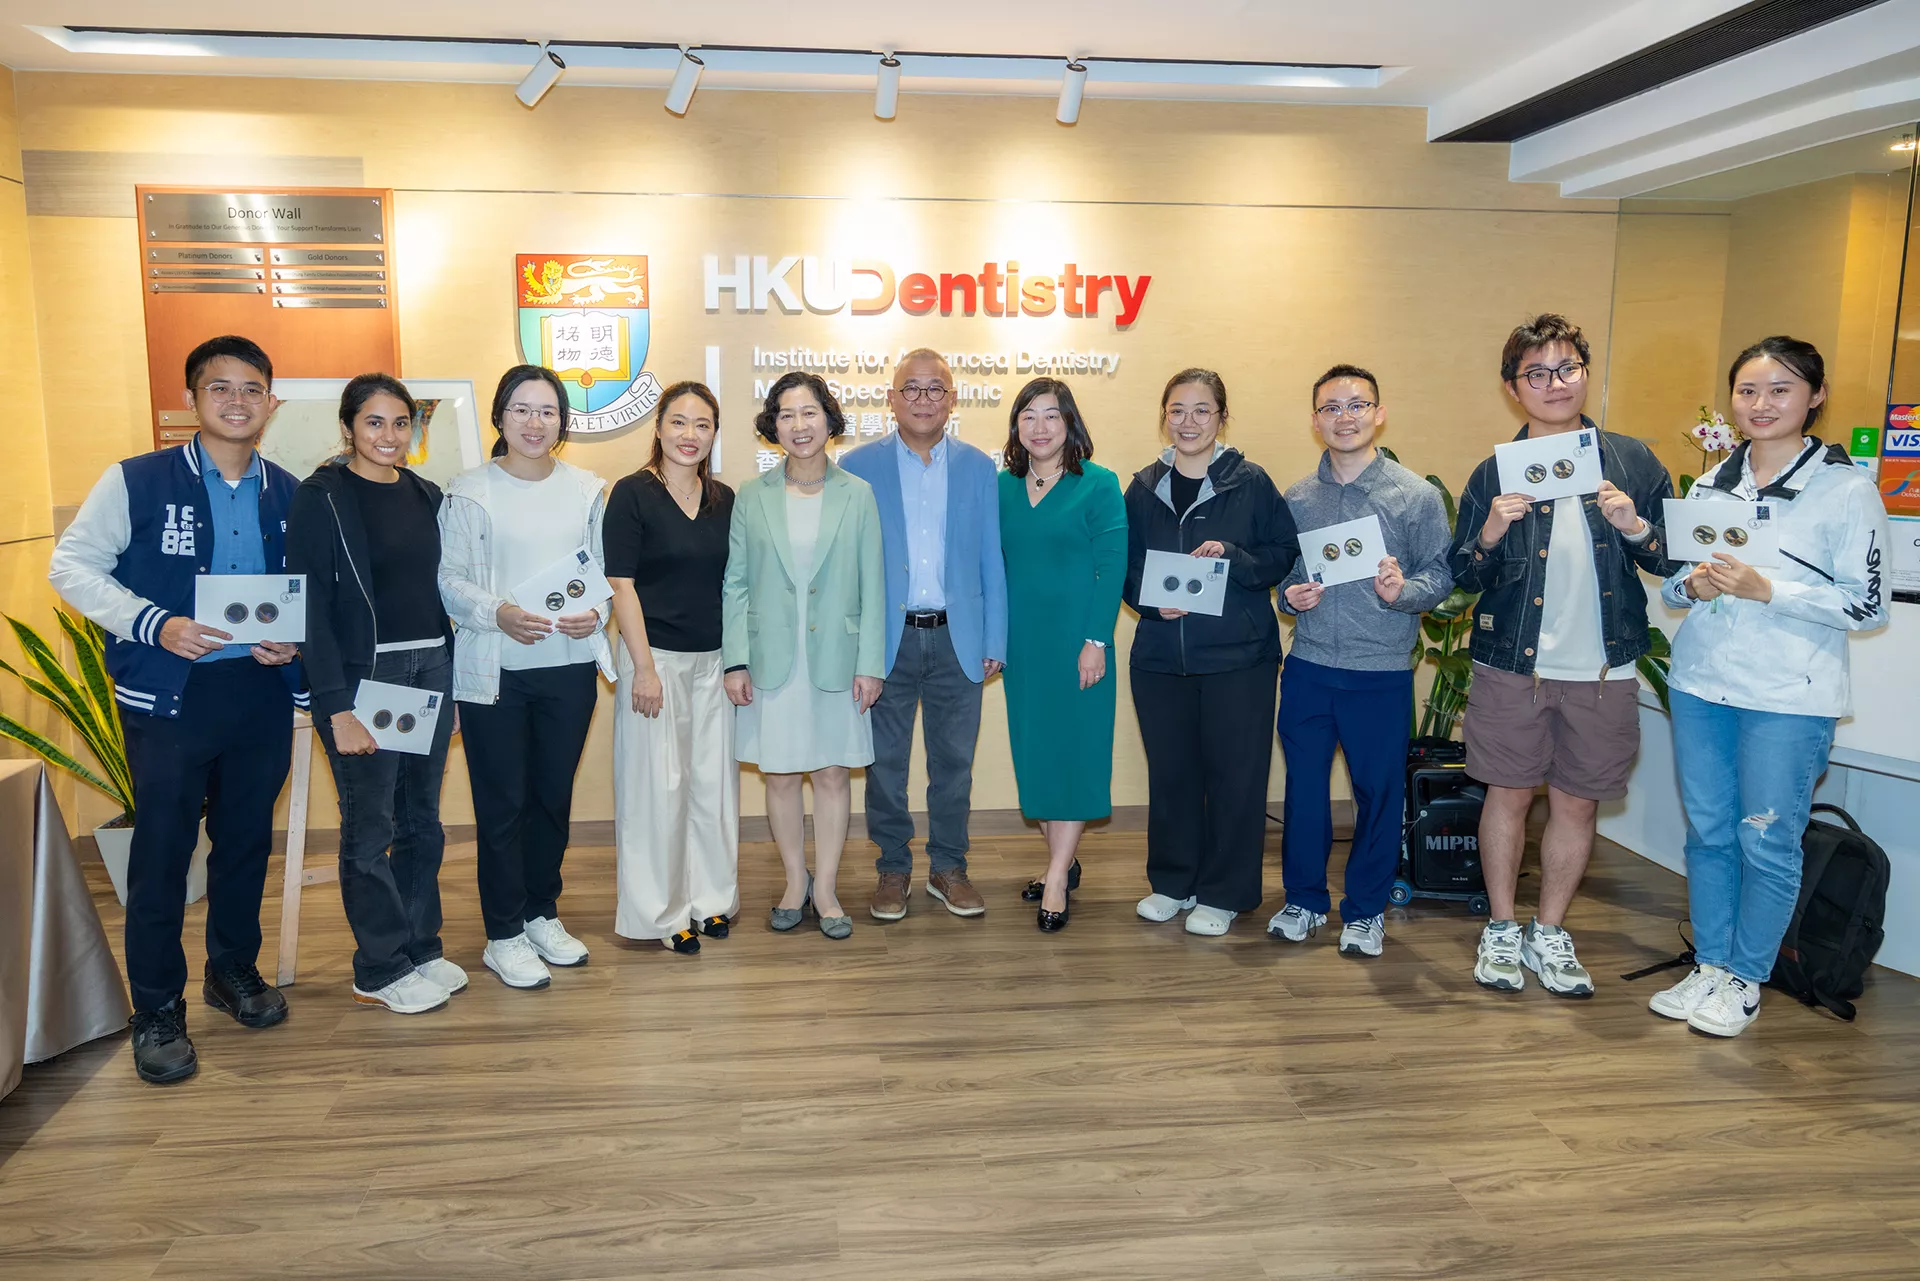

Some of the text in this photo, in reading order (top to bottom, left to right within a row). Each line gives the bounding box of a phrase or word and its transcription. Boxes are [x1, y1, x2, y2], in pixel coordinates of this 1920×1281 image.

[228, 207, 301, 220] Donor Wall
[175, 223, 201, 231] Gratitude
[203, 223, 210, 231] to
[211, 223, 222, 231] Our
[291, 225, 313, 233] Support
[315, 225, 347, 233] Transforms
[178, 252, 233, 260] Platinum Donors
[307, 253, 323, 261] Gold
[753, 346, 850, 368] Institute
[856, 348, 890, 368] for
[1016, 349, 1120, 373] Dentistry
[953, 380, 1002, 401] linic
[587, 416, 605, 430] ET
[610, 389, 659, 425] VIRTUS
[1889, 413, 1920, 421] MasterC
[1891, 434, 1920, 447] VIS
[161, 529, 196, 557] 82
[1425, 835, 1478, 850] MIPR
